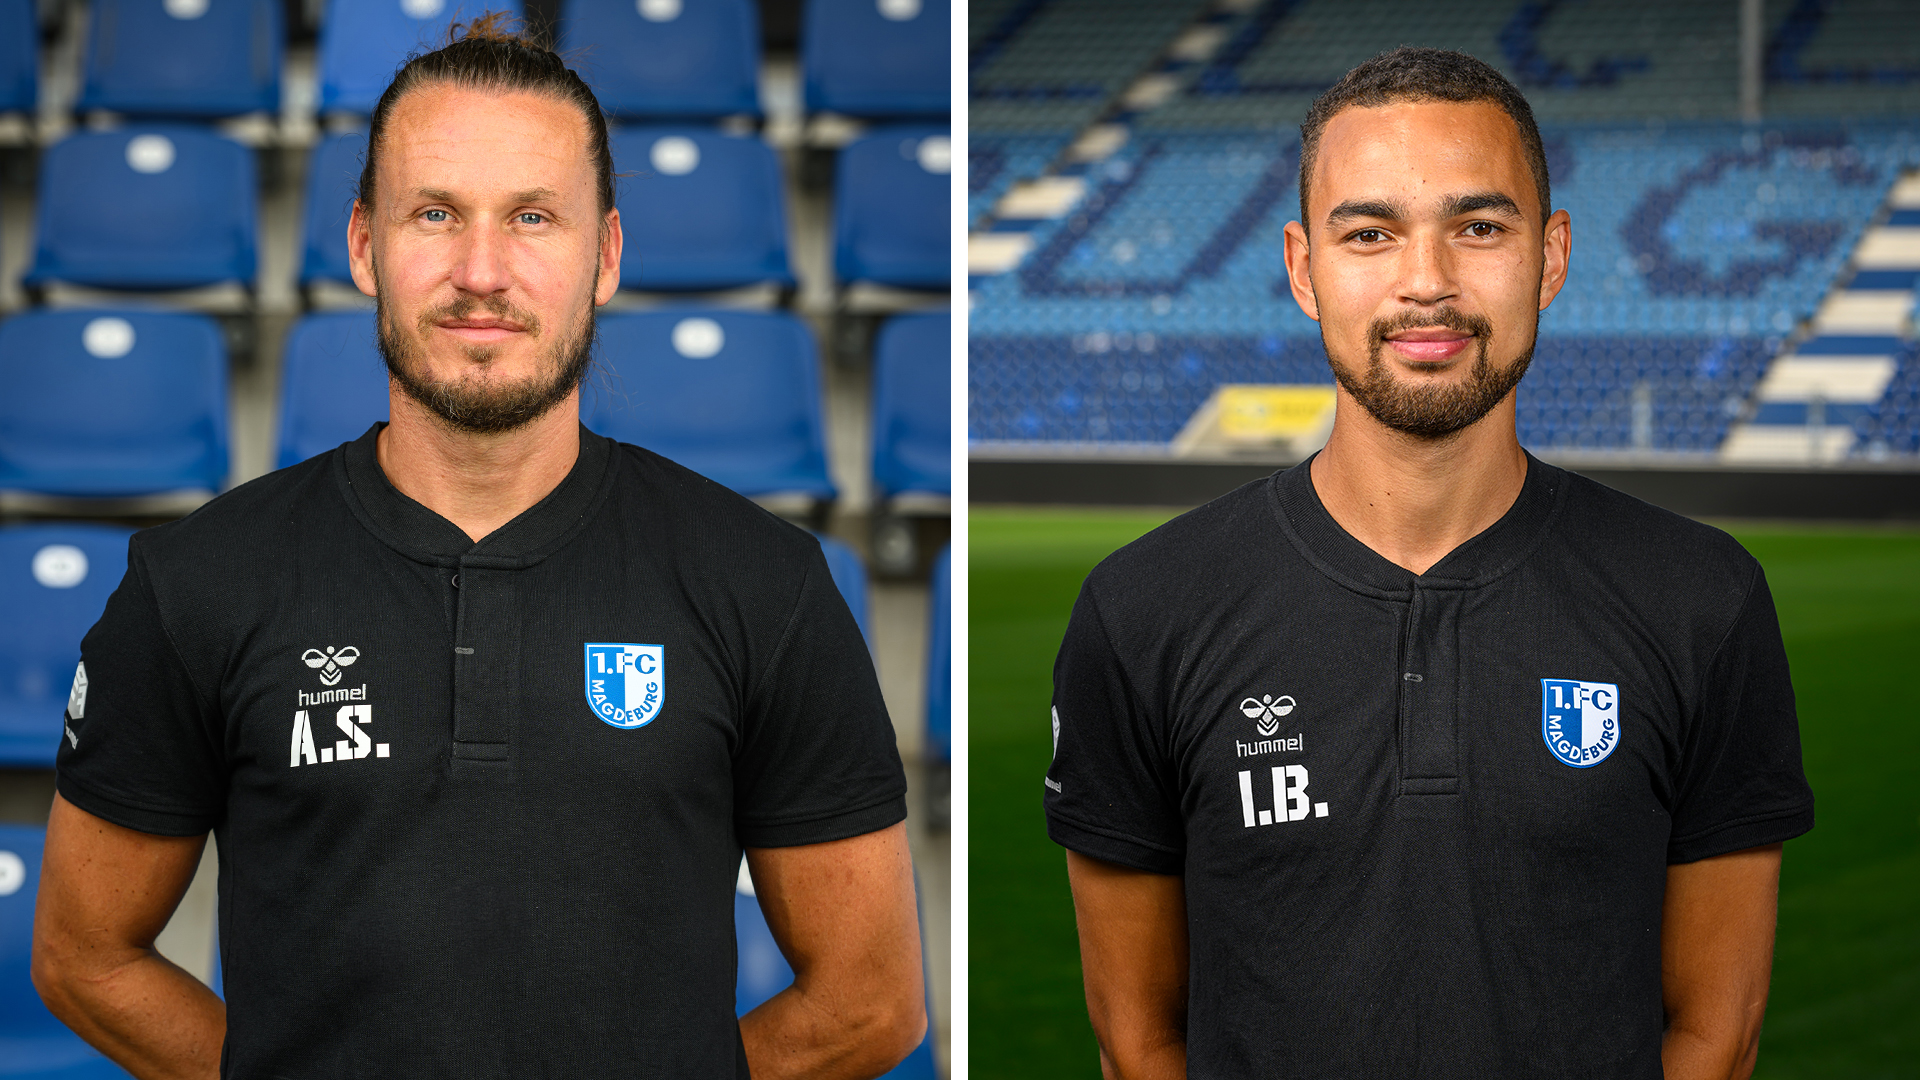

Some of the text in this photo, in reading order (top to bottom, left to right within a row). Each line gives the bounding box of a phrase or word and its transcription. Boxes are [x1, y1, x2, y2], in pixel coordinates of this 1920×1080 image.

[298, 683, 367, 706] hummel
[592, 680, 658, 722] MAGDEBURG
[290, 704, 390, 767] A.S.
[1236, 732, 1303, 757] hummel
[1549, 715, 1615, 761] MAGDEBURG
[1238, 764, 1329, 828] I.B.
